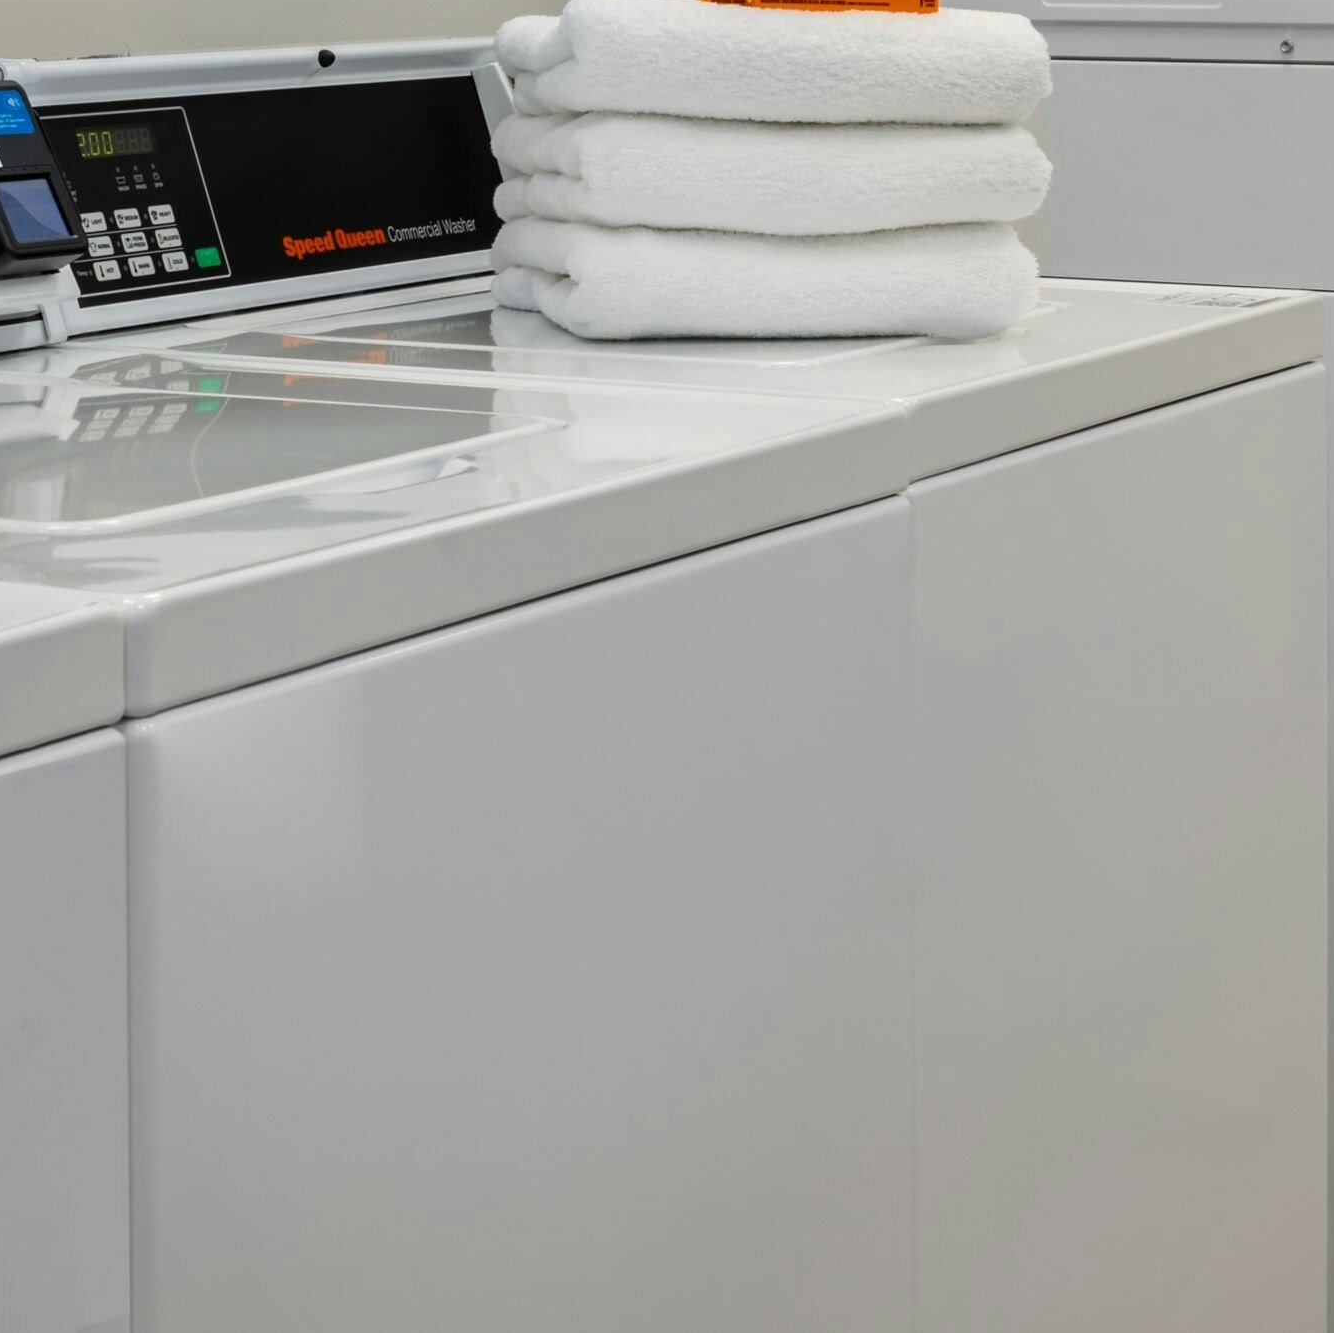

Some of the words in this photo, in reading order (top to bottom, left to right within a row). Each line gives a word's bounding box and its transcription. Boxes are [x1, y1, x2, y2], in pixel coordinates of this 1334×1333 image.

[283, 232, 335, 260] Speed
[337, 228, 386, 249] Queen
[388, 220, 442, 242] Commercial
[442, 216, 476, 234] Washer
